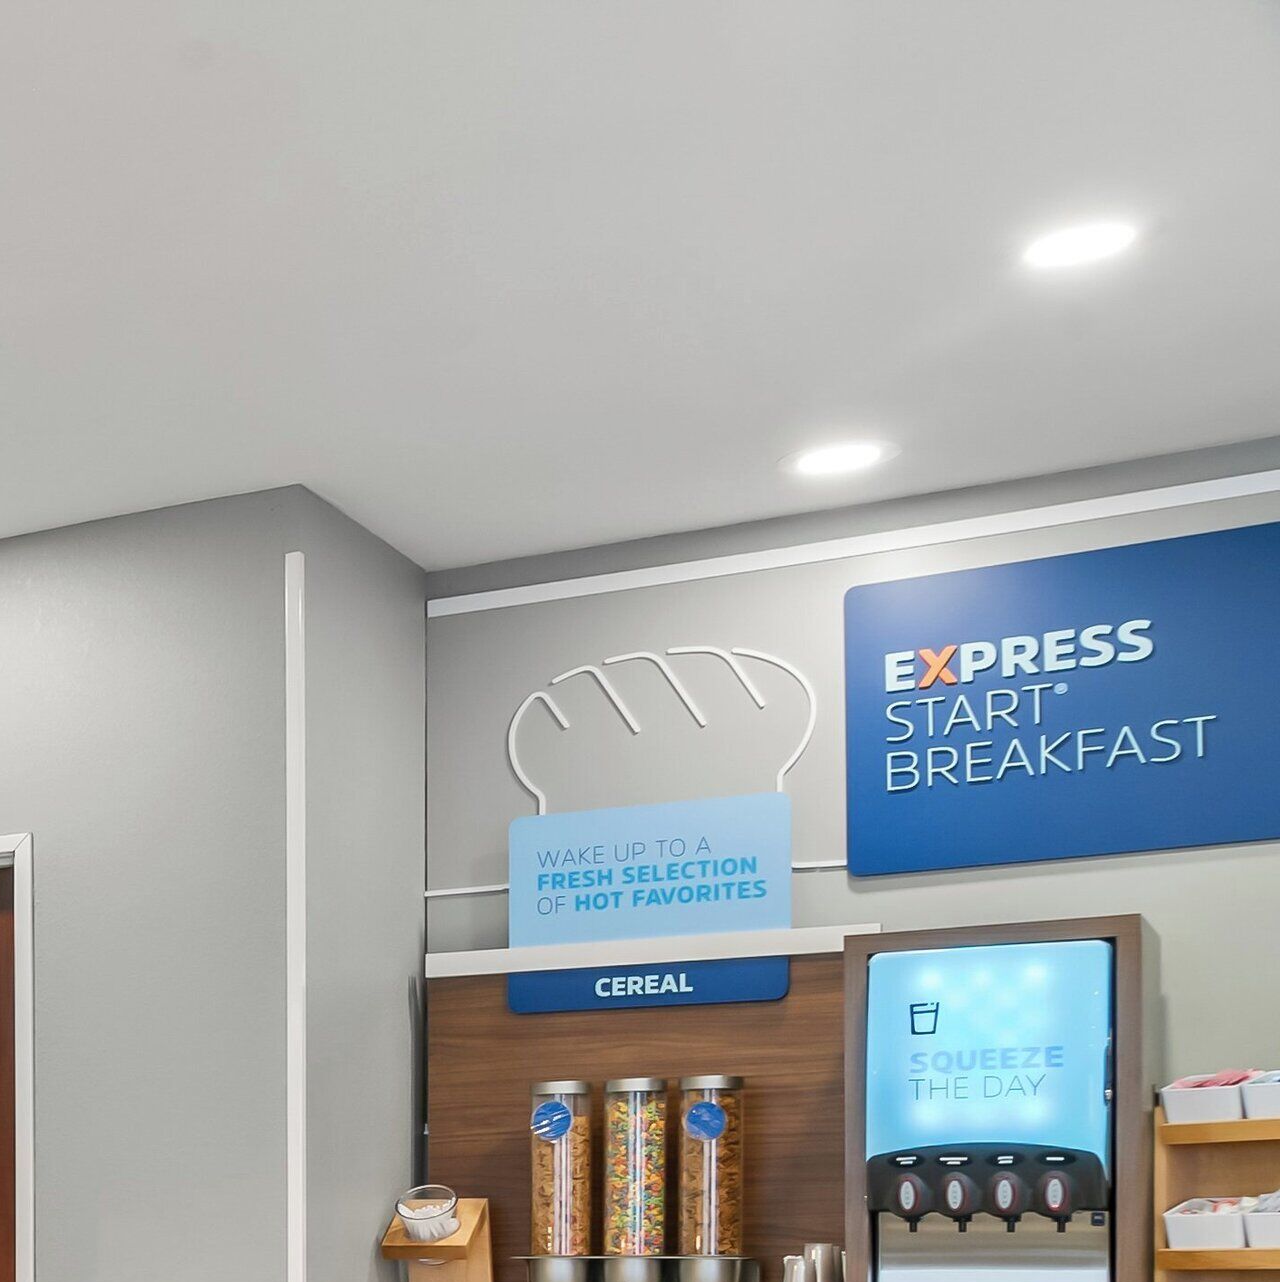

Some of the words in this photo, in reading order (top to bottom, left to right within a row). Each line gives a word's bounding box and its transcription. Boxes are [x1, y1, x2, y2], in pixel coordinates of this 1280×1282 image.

[884, 618, 1154, 693] EXPRESS
[886, 714, 1217, 793] BREAKFAST
[537, 845, 605, 868] WAKE
[614, 842, 646, 863] UP
[656, 838, 686, 859] TO
[696, 836, 712, 854] A
[537, 866, 613, 891] FRESH
[622, 856, 758, 884] SELECTION
[537, 895, 567, 915] OF
[575, 890, 624, 912] HOT
[632, 879, 768, 907] FAVORITES
[594, 972, 694, 998] CEREAL
[909, 1046, 1064, 1075] SQUEEZE
[908, 1076, 969, 1101] THE
[984, 1073, 1046, 1099] DAY
